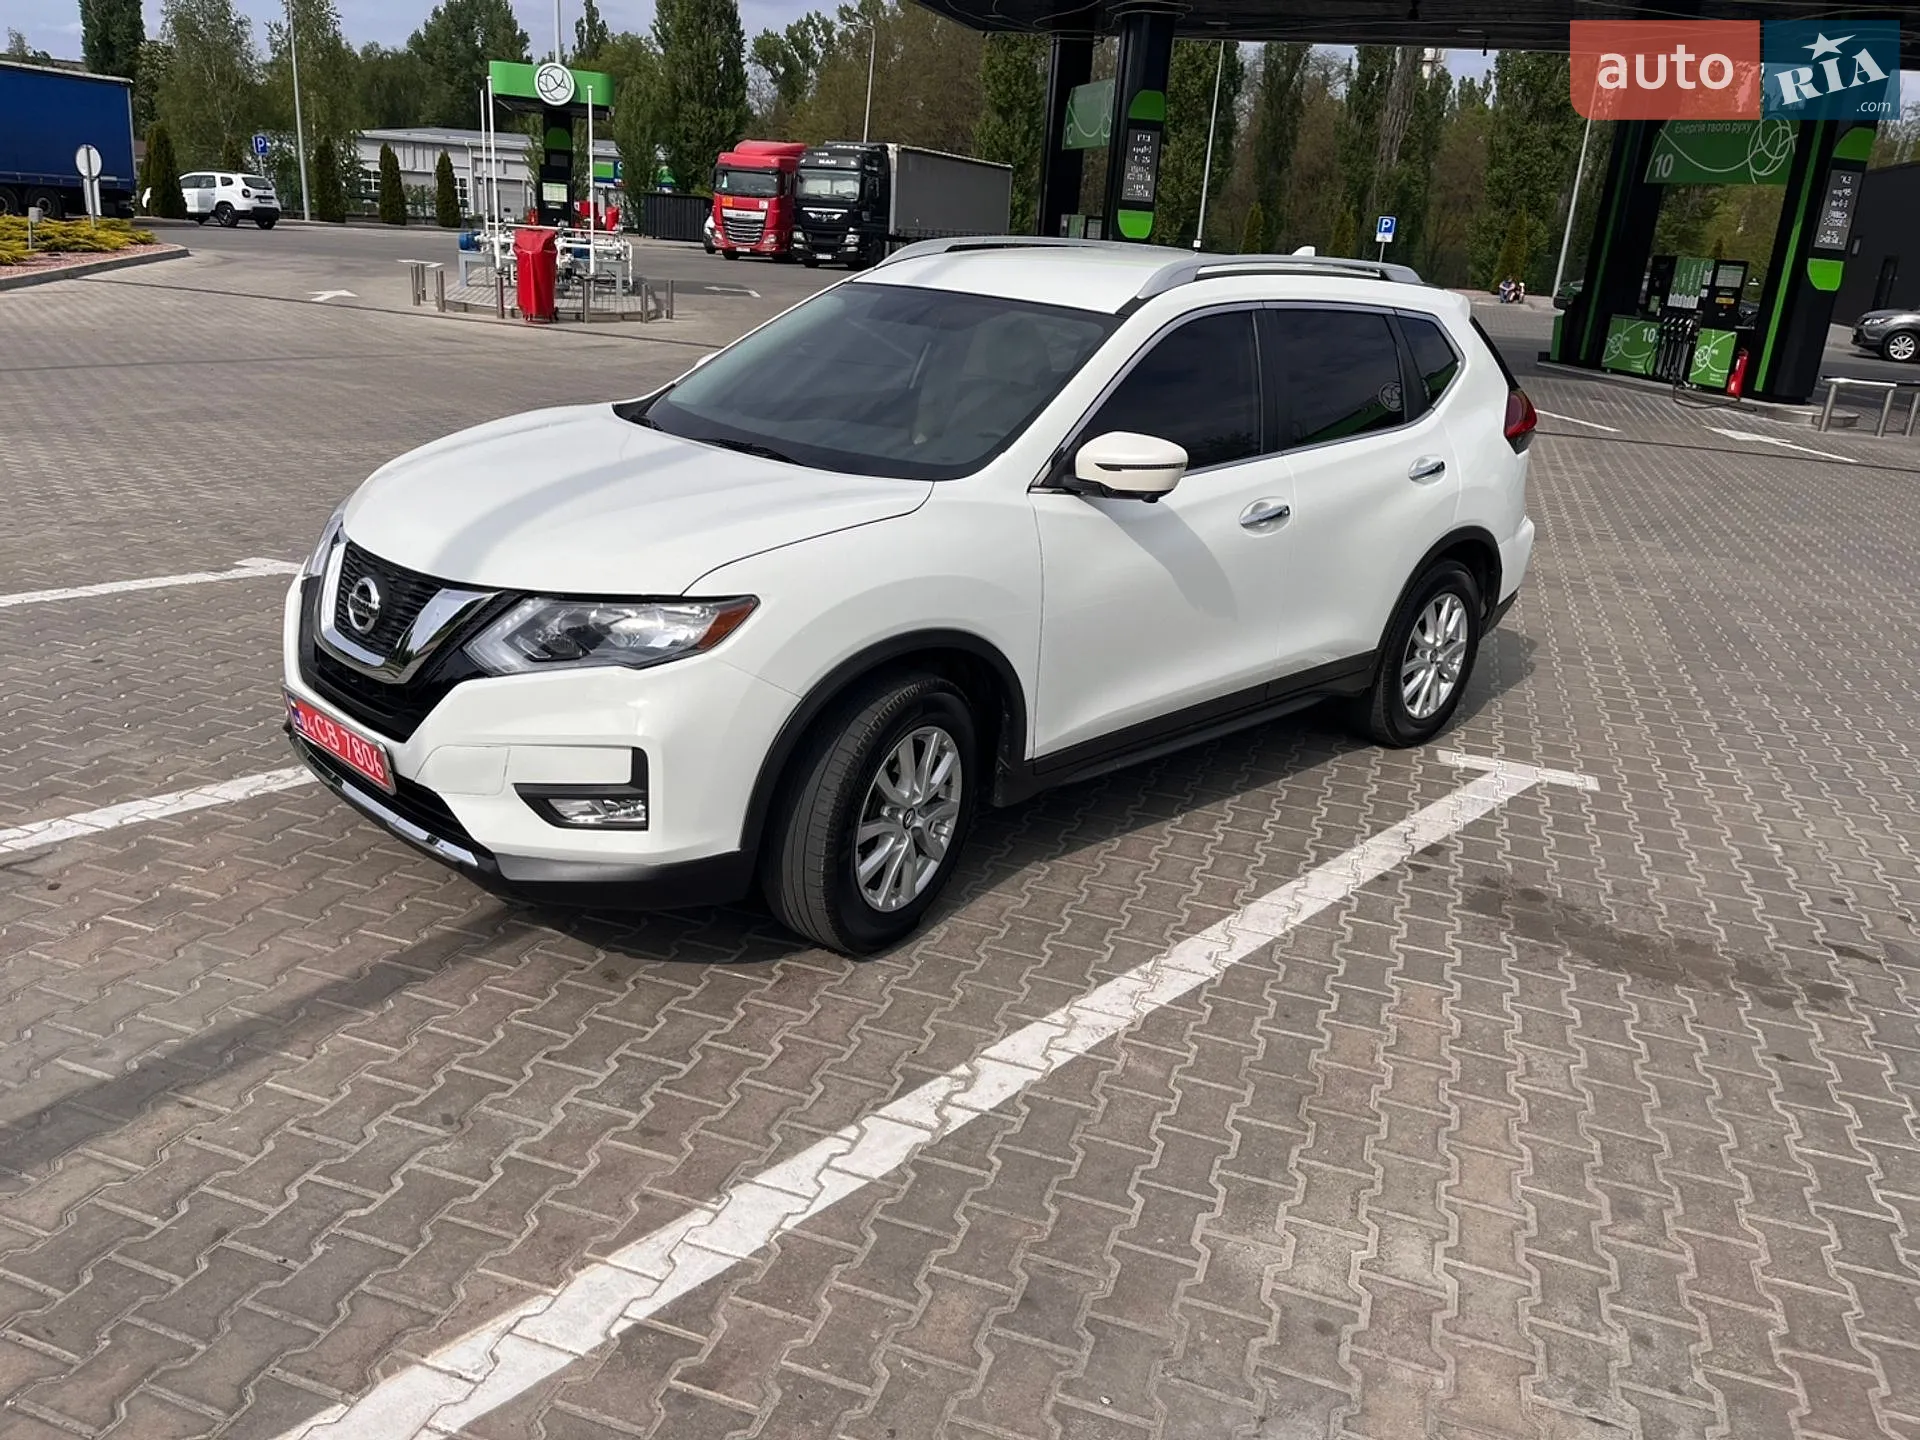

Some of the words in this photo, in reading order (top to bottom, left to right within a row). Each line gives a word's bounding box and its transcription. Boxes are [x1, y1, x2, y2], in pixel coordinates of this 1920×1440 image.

[257, 137, 265, 152] P
[1654, 153, 1674, 178] 10
[1381, 218, 1392, 232] P
[1642, 327, 1656, 343] 10
[340, 729, 384, 779] 7806
